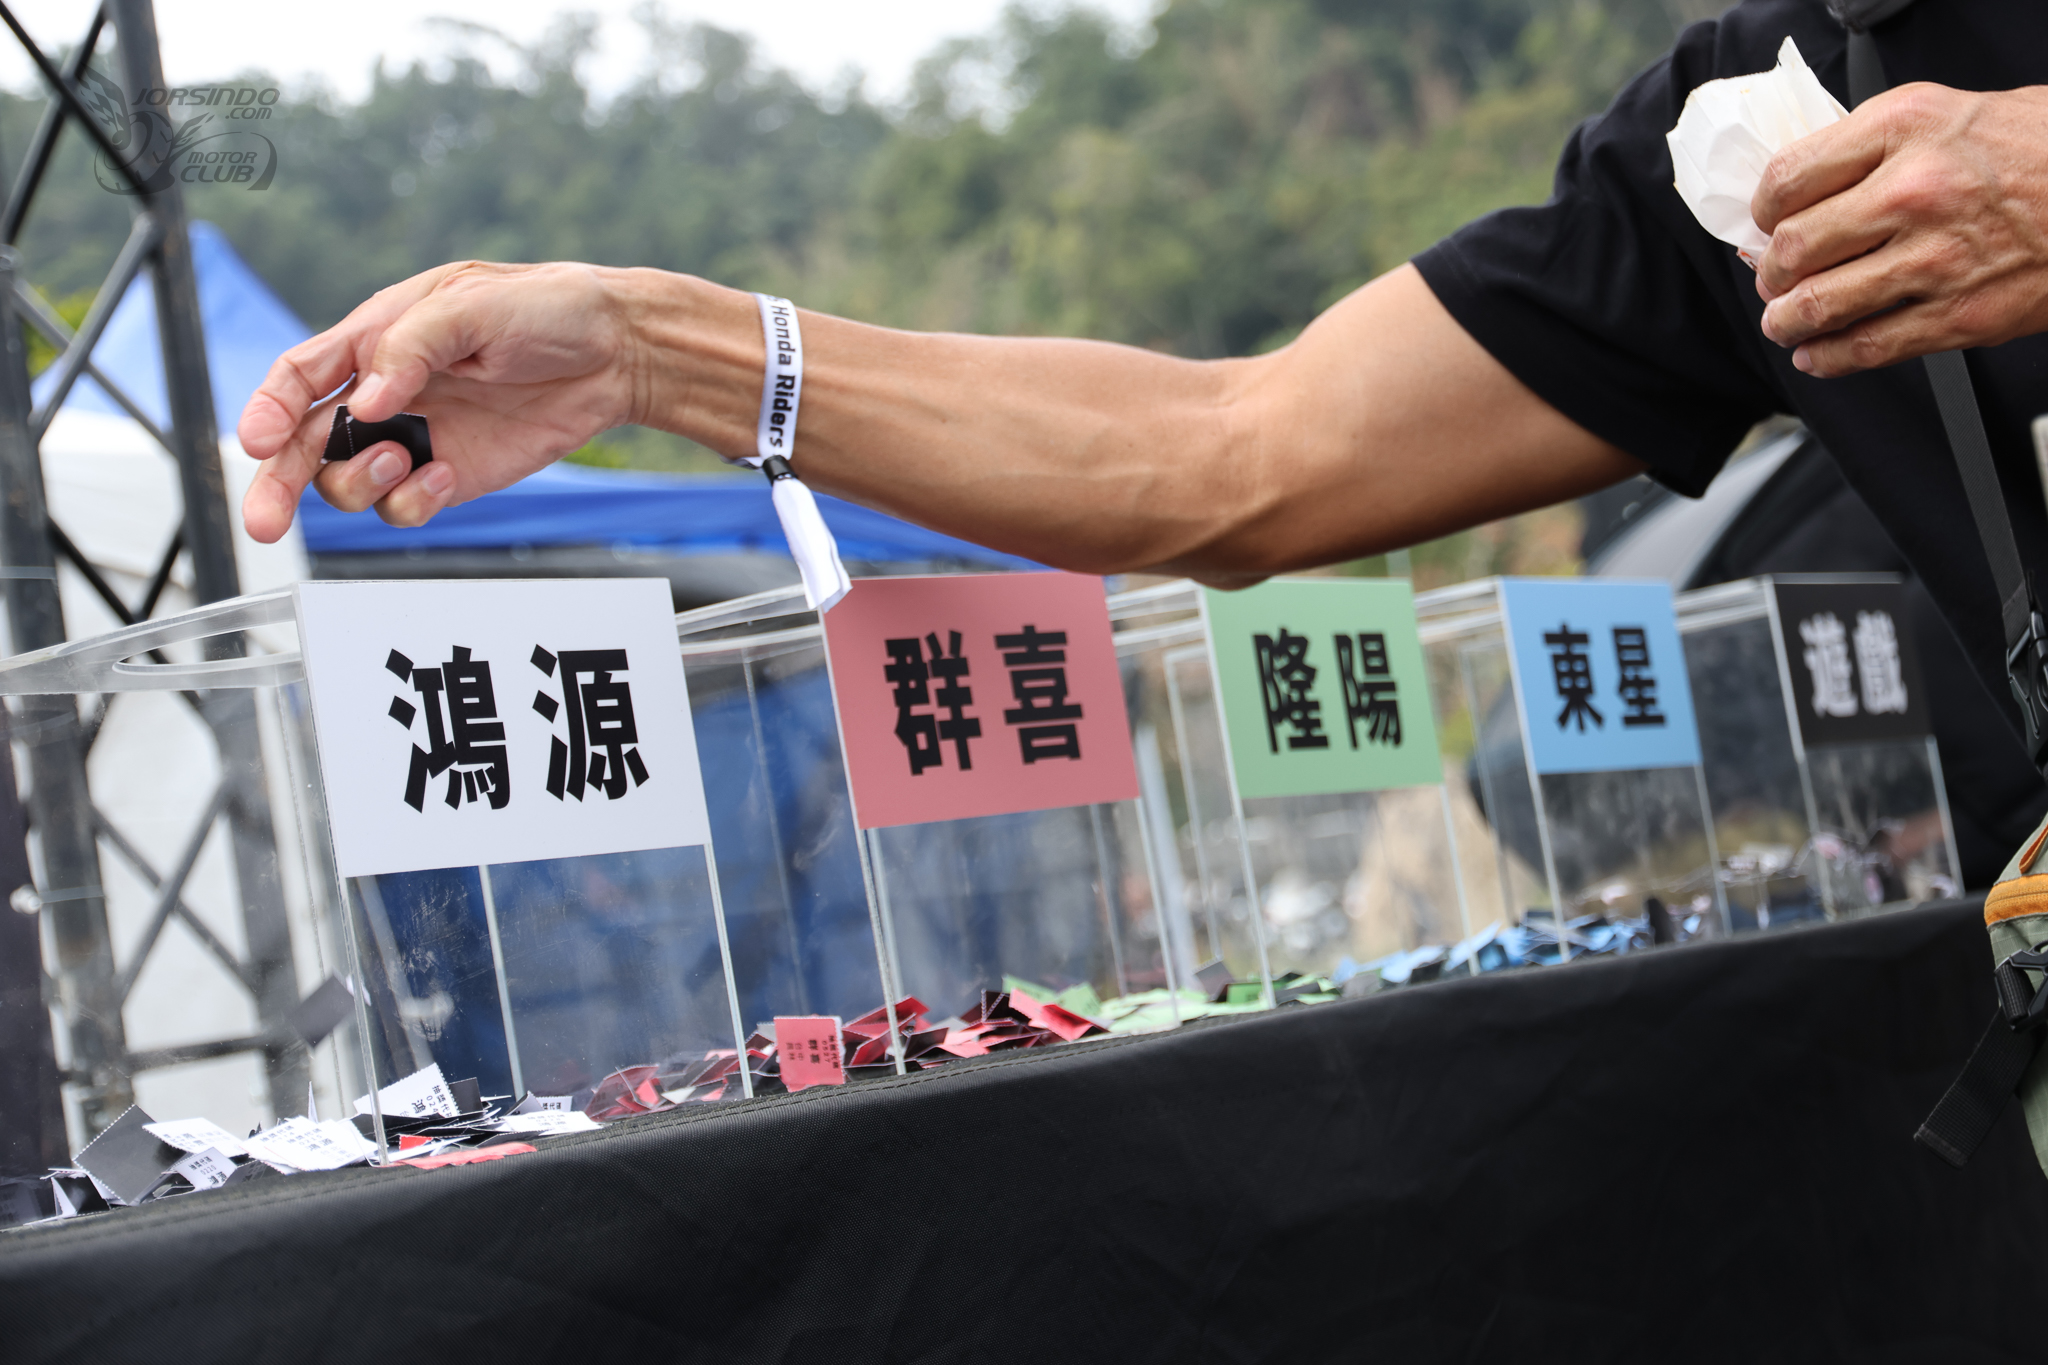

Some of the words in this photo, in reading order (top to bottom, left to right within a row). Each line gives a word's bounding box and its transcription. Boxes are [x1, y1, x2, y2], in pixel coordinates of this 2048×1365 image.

[771, 305, 796, 366] Honda
[769, 374, 796, 448] Riders
[386, 645, 649, 813] 鴻源
[884, 625, 1083, 776] 群喜
[1253, 627, 1402, 754] 隆陽
[1543, 623, 1667, 732] 東星
